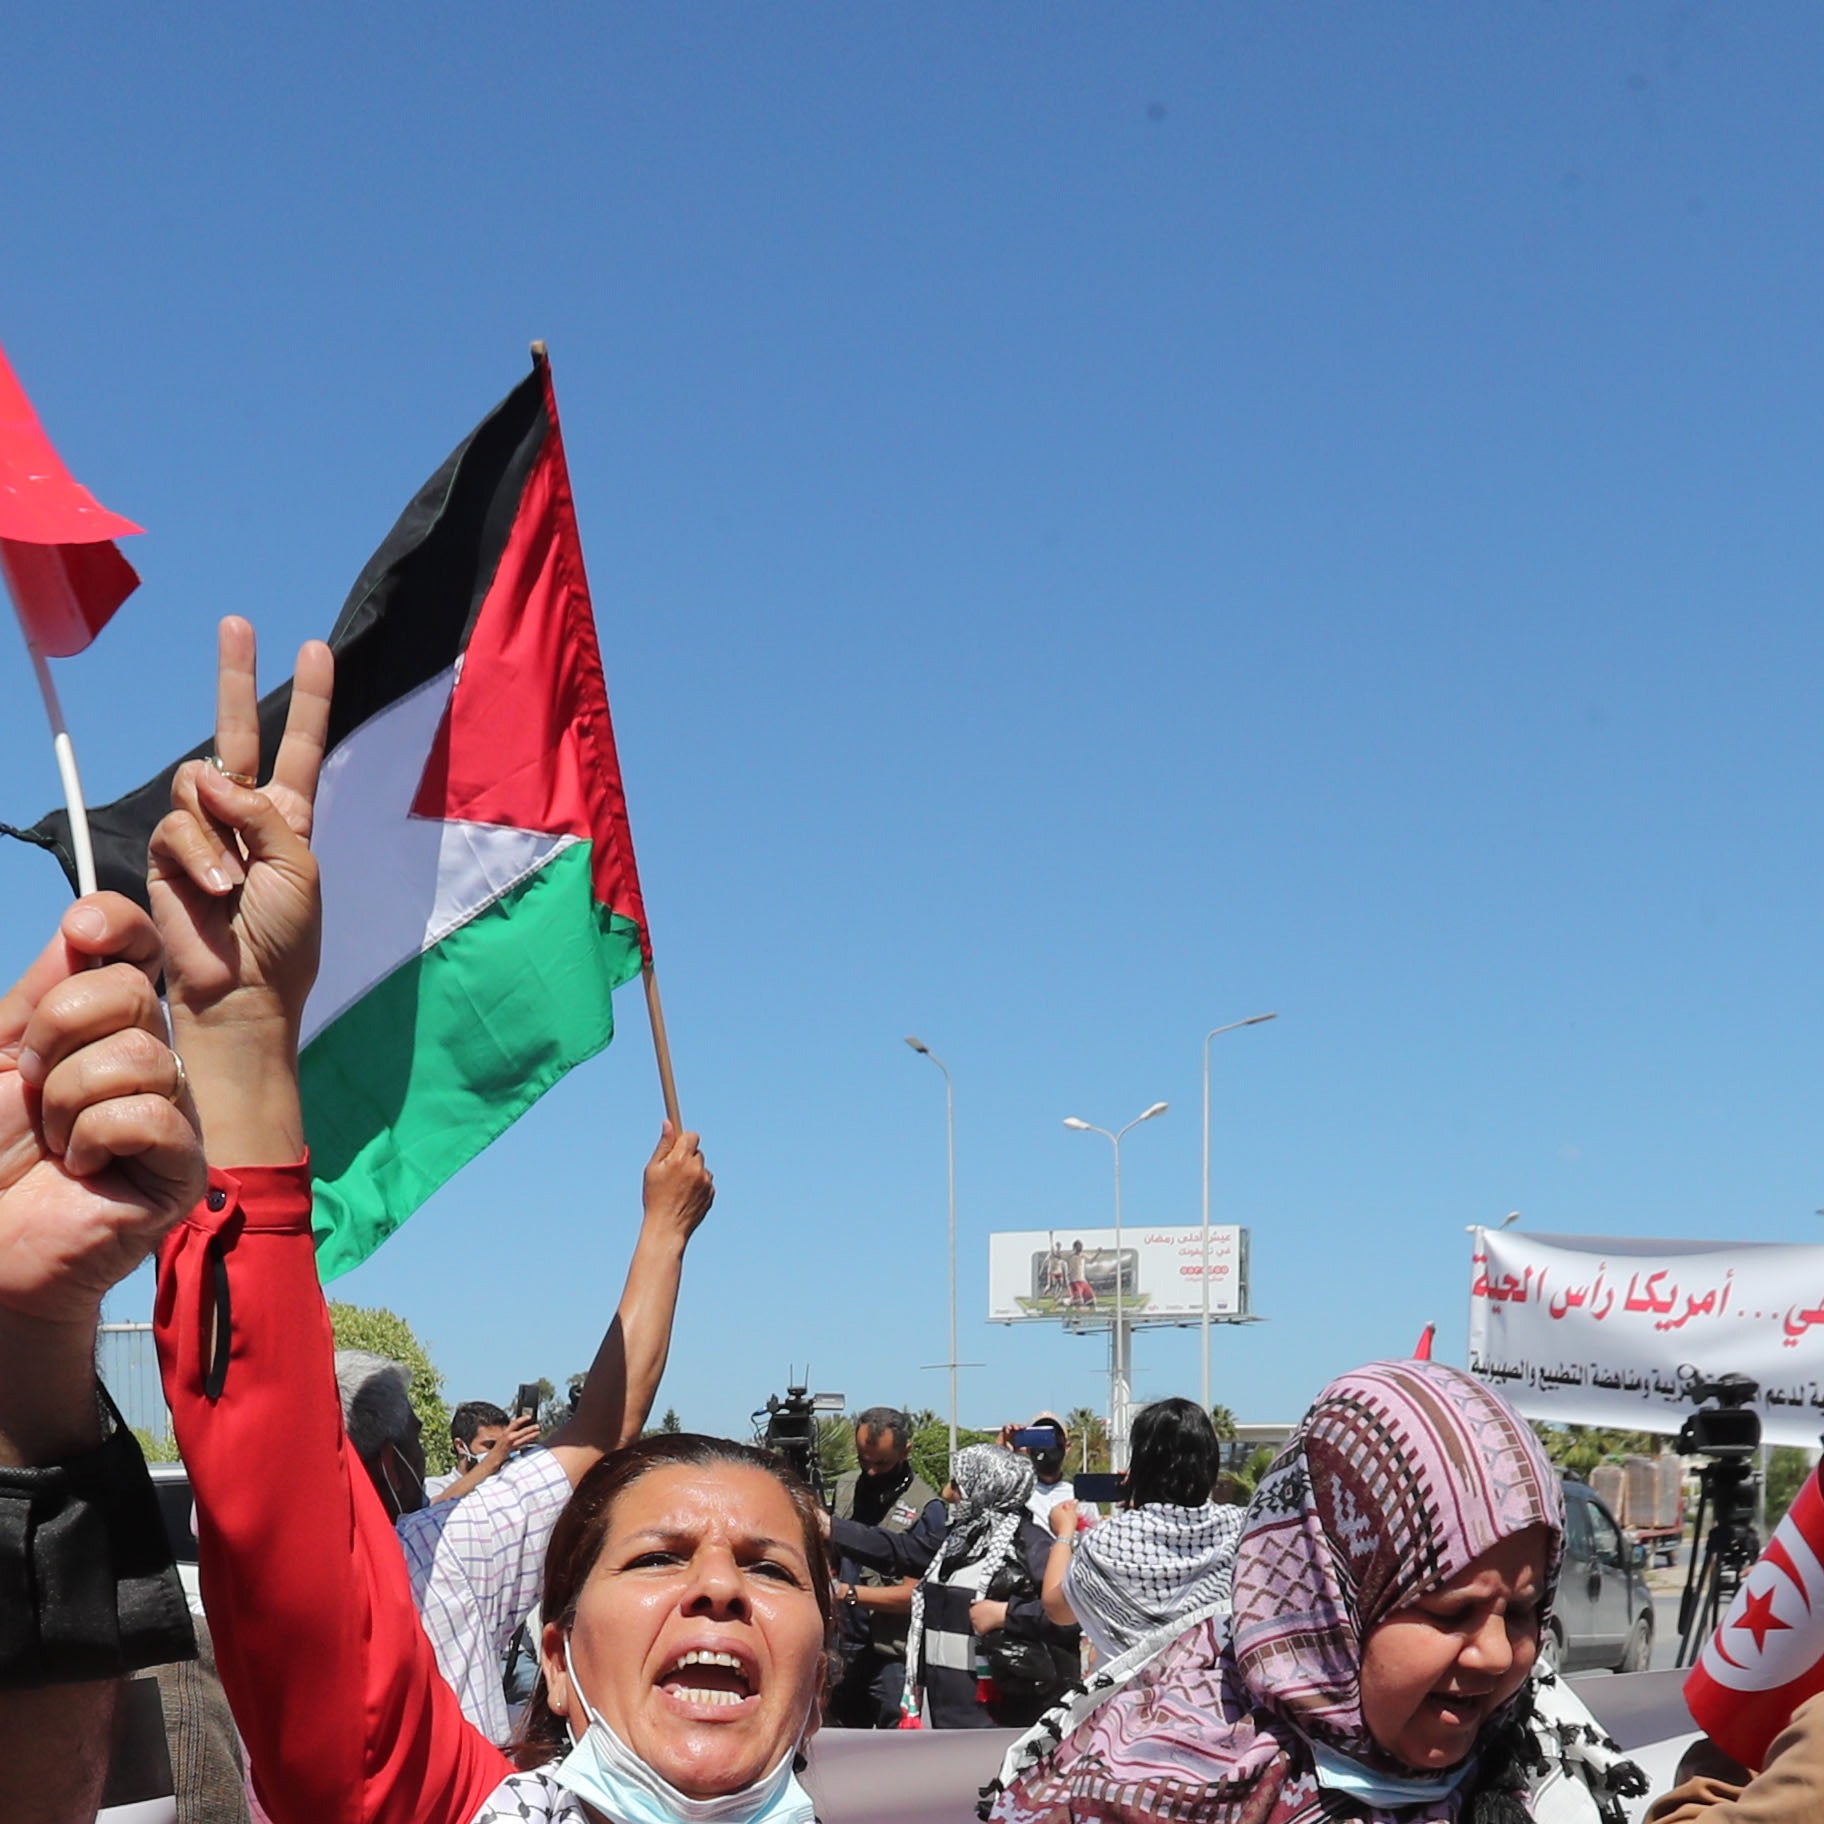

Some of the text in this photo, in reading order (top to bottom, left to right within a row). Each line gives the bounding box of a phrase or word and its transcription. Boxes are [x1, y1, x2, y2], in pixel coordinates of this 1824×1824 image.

[1471, 1253, 1549, 1315] الحية
[1549, 1260, 1615, 1320] رأس
[1622, 1267, 1735, 1331] أمريكا
[1469, 1350, 1537, 1388] والصهيونية
[1539, 1362, 1589, 1393] التطبيع
